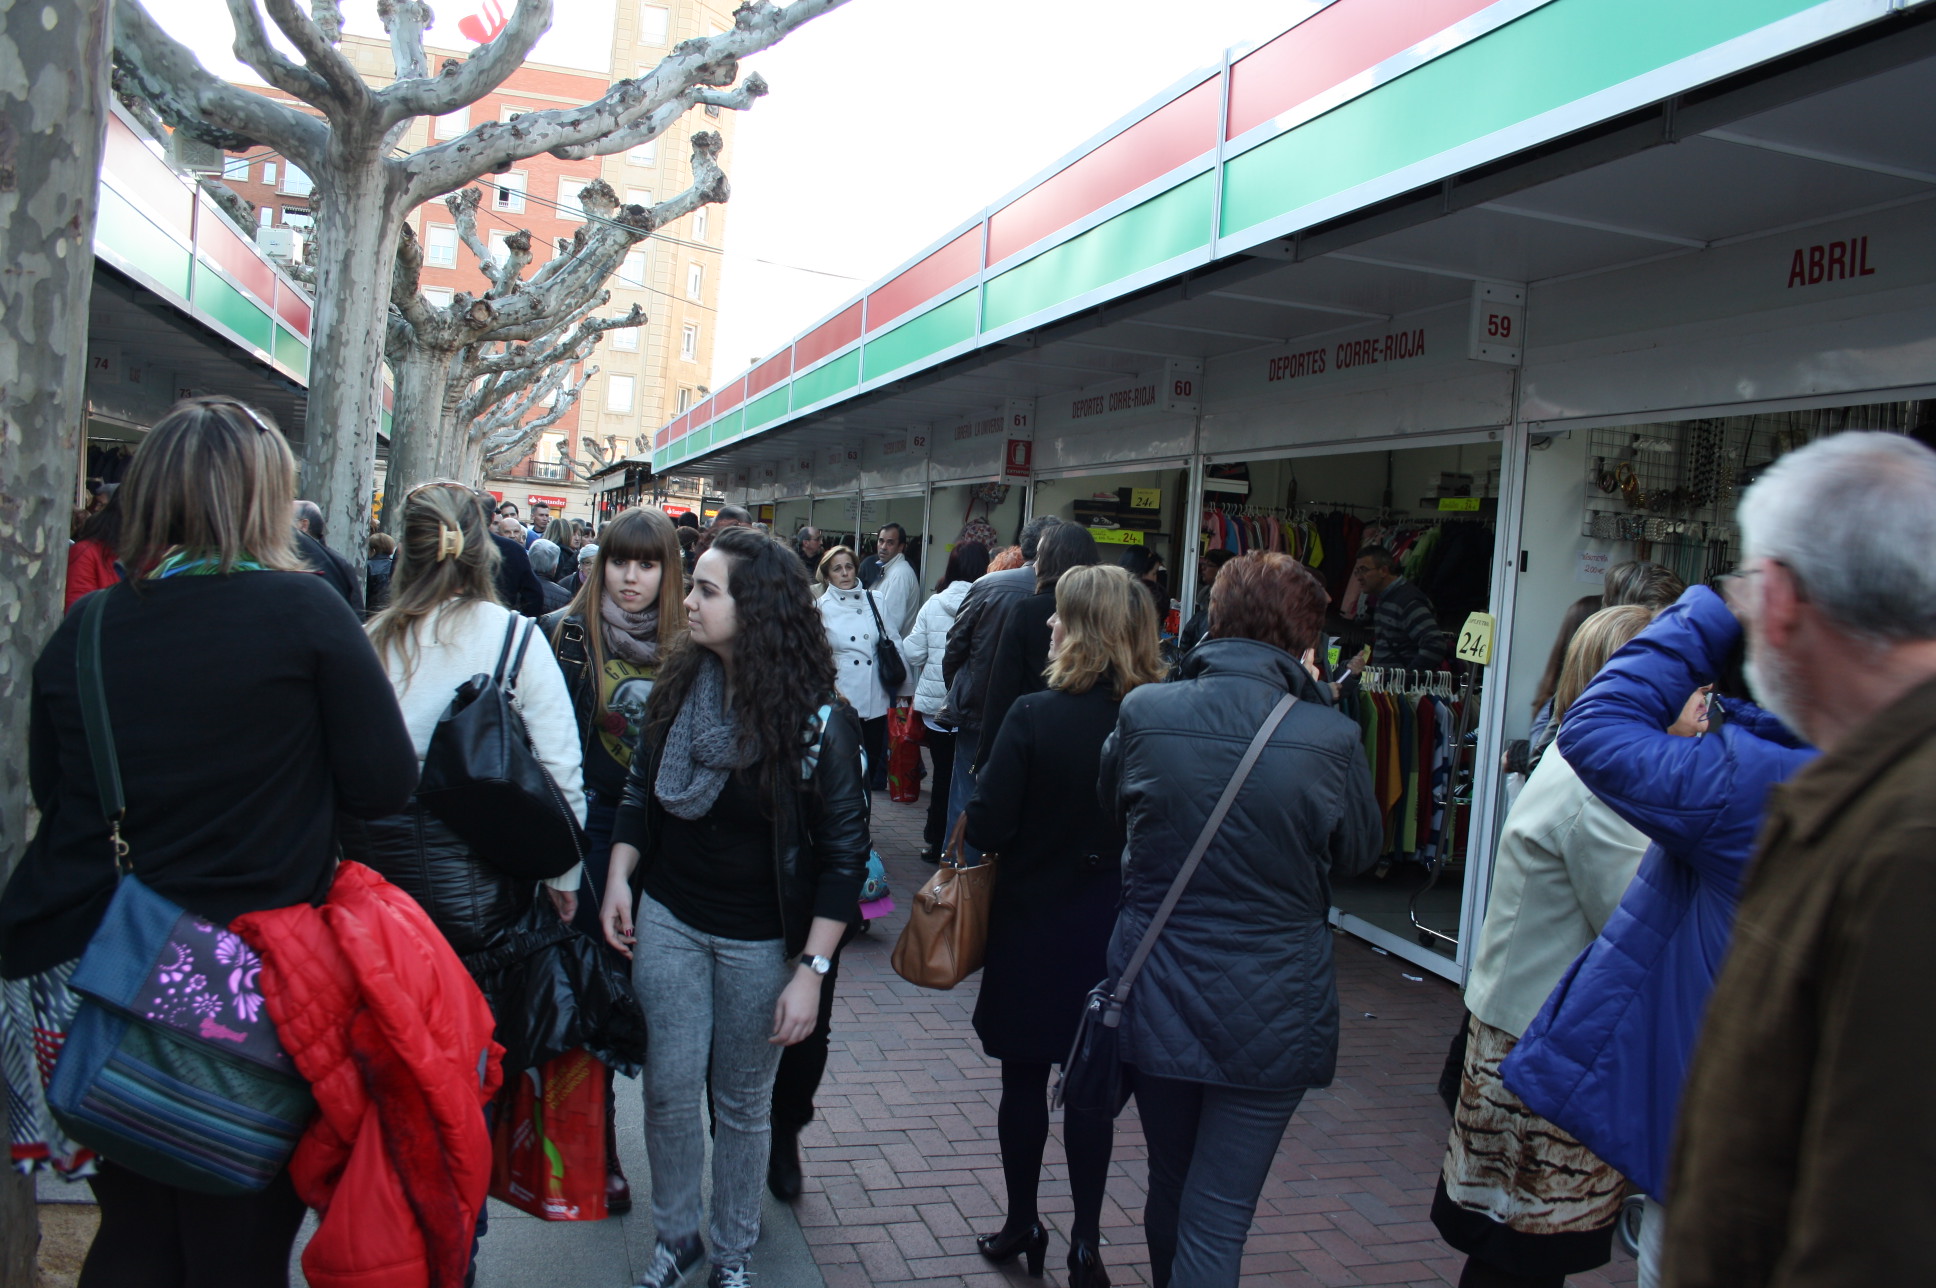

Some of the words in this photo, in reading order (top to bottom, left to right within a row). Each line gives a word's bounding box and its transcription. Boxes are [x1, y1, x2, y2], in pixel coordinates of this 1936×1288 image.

[1788, 236, 1875, 288] ABRIL
[1487, 314, 1511, 337] 59
[1269, 349, 1326, 382] DEPORTES
[1336, 329, 1425, 370] CORRE-RIOJA
[94, 357, 109, 370] 74
[179, 388, 192, 398] 73
[1174, 380, 1192, 396] 60
[1072, 396, 1104, 419] DEPORTES
[1109, 385, 1155, 412] CORRE-RIOJA
[1014, 415, 1026, 426] 61
[914, 436, 925, 447] 62
[847, 451, 858, 460] 63
[1122, 532, 1137, 543] 24
[1459, 632, 1486, 657] 24€
